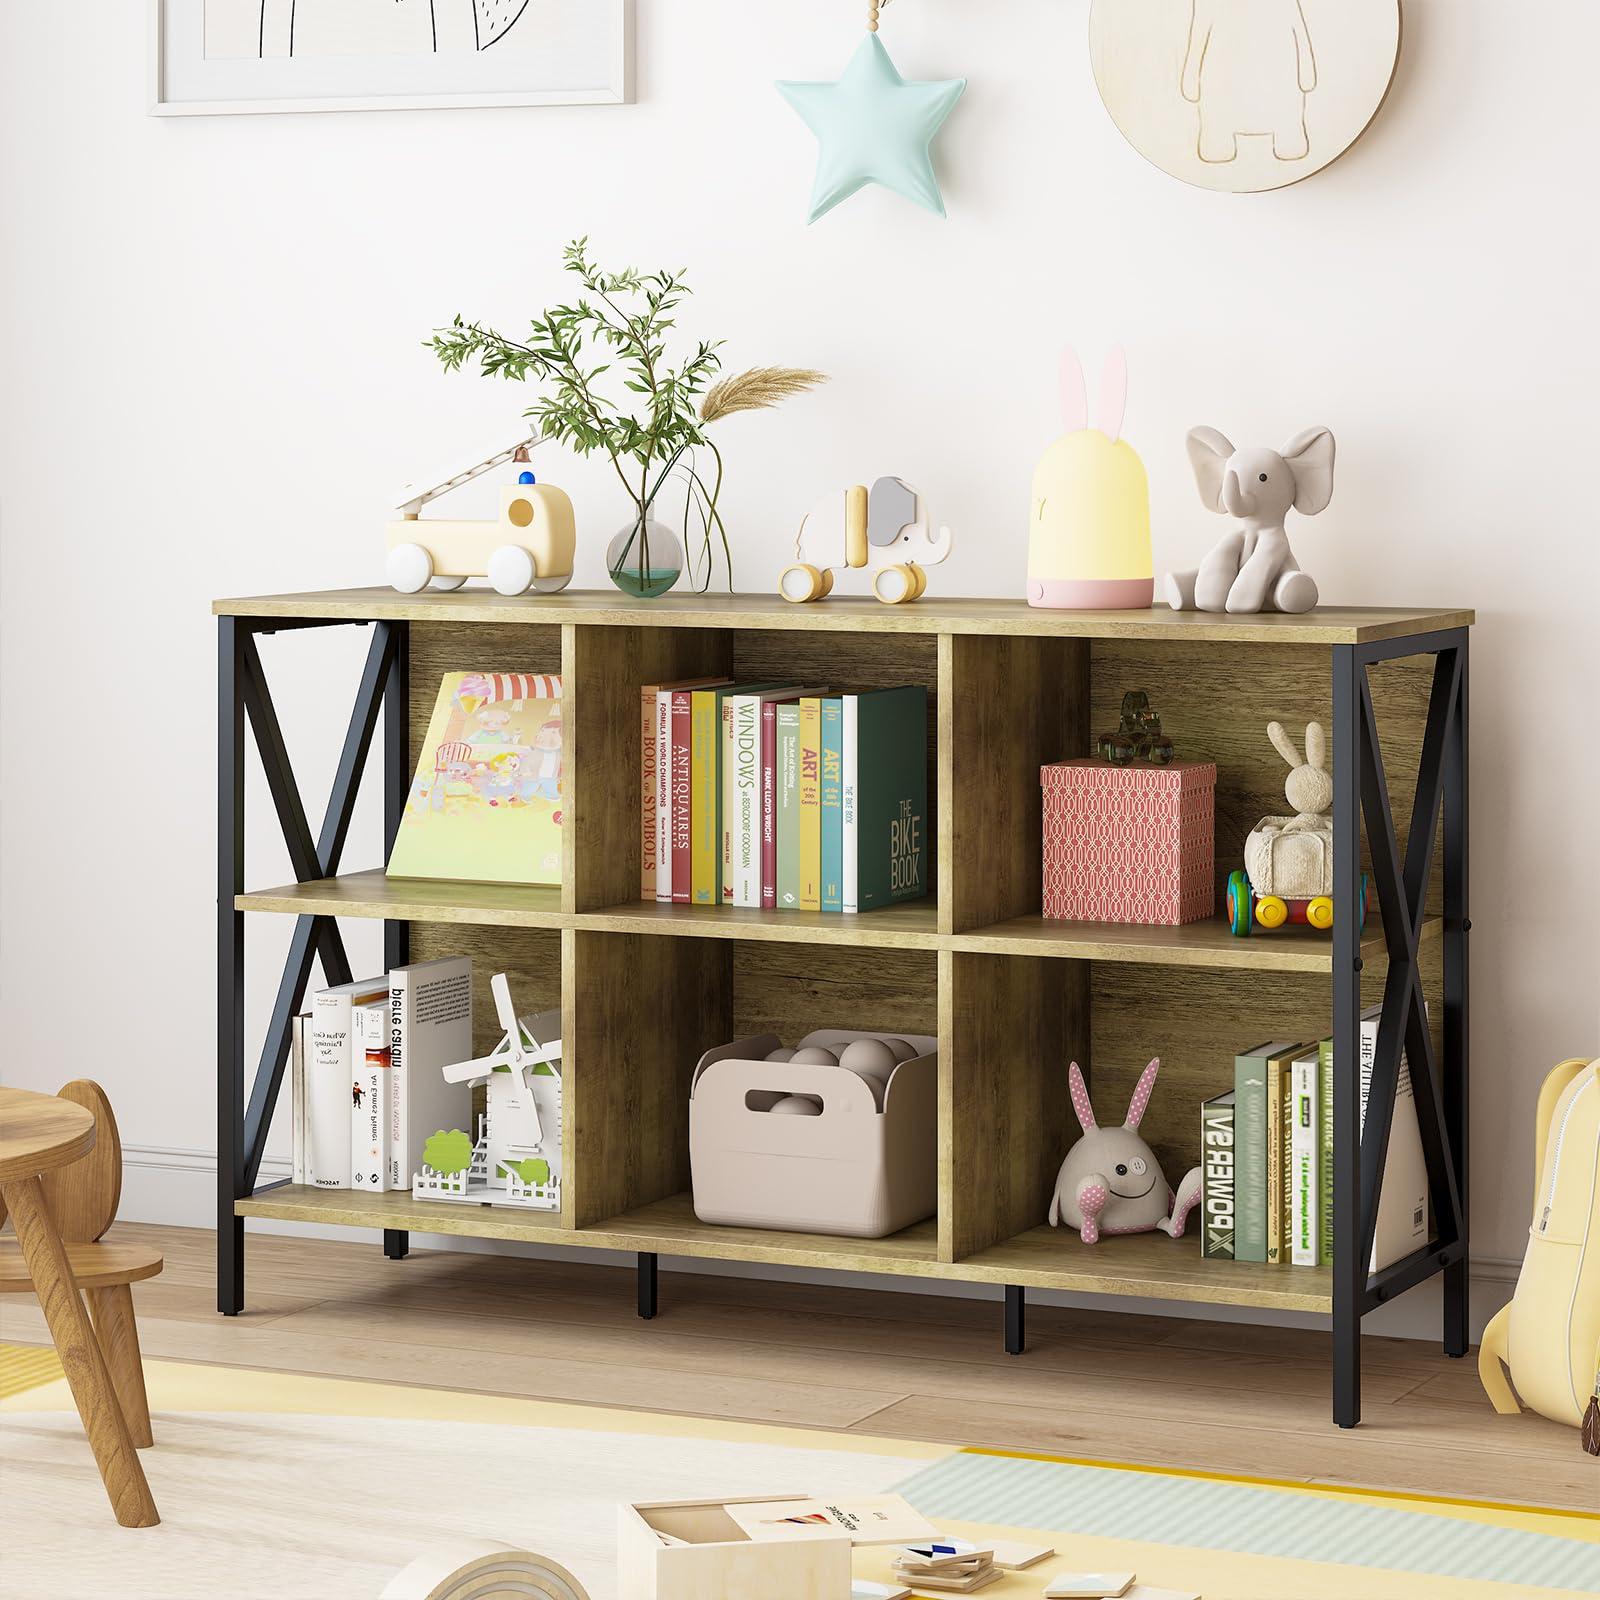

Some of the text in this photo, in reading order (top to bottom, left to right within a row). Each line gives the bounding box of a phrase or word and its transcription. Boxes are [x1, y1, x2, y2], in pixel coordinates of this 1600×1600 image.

[659, 703, 667, 735] FORMULA
[644, 737, 656, 779] BOOK
[659, 742, 667, 767] WORLD
[738, 703, 755, 788] WINDOWS
[787, 765, 795, 789] Knitting
[801, 748, 818, 781] ART
[823, 748, 840, 783] ART
[644, 782, 650, 792] OF
[659, 767, 667, 807] CHAMPIONS
[676, 745, 689, 849] ANTIQUAIRES
[742, 797, 751, 832] BERGDORF
[764, 767, 772, 843] FRANK LLOYD WRIGHT
[845, 786, 853, 825] THE BIKE BOOK
[899, 799, 913, 817] THE
[644, 795, 656, 871] SYMBOLS
[890, 815, 921, 858] BIKE
[742, 833, 751, 869] GOODMAN
[890, 855, 920, 890] BOOK
